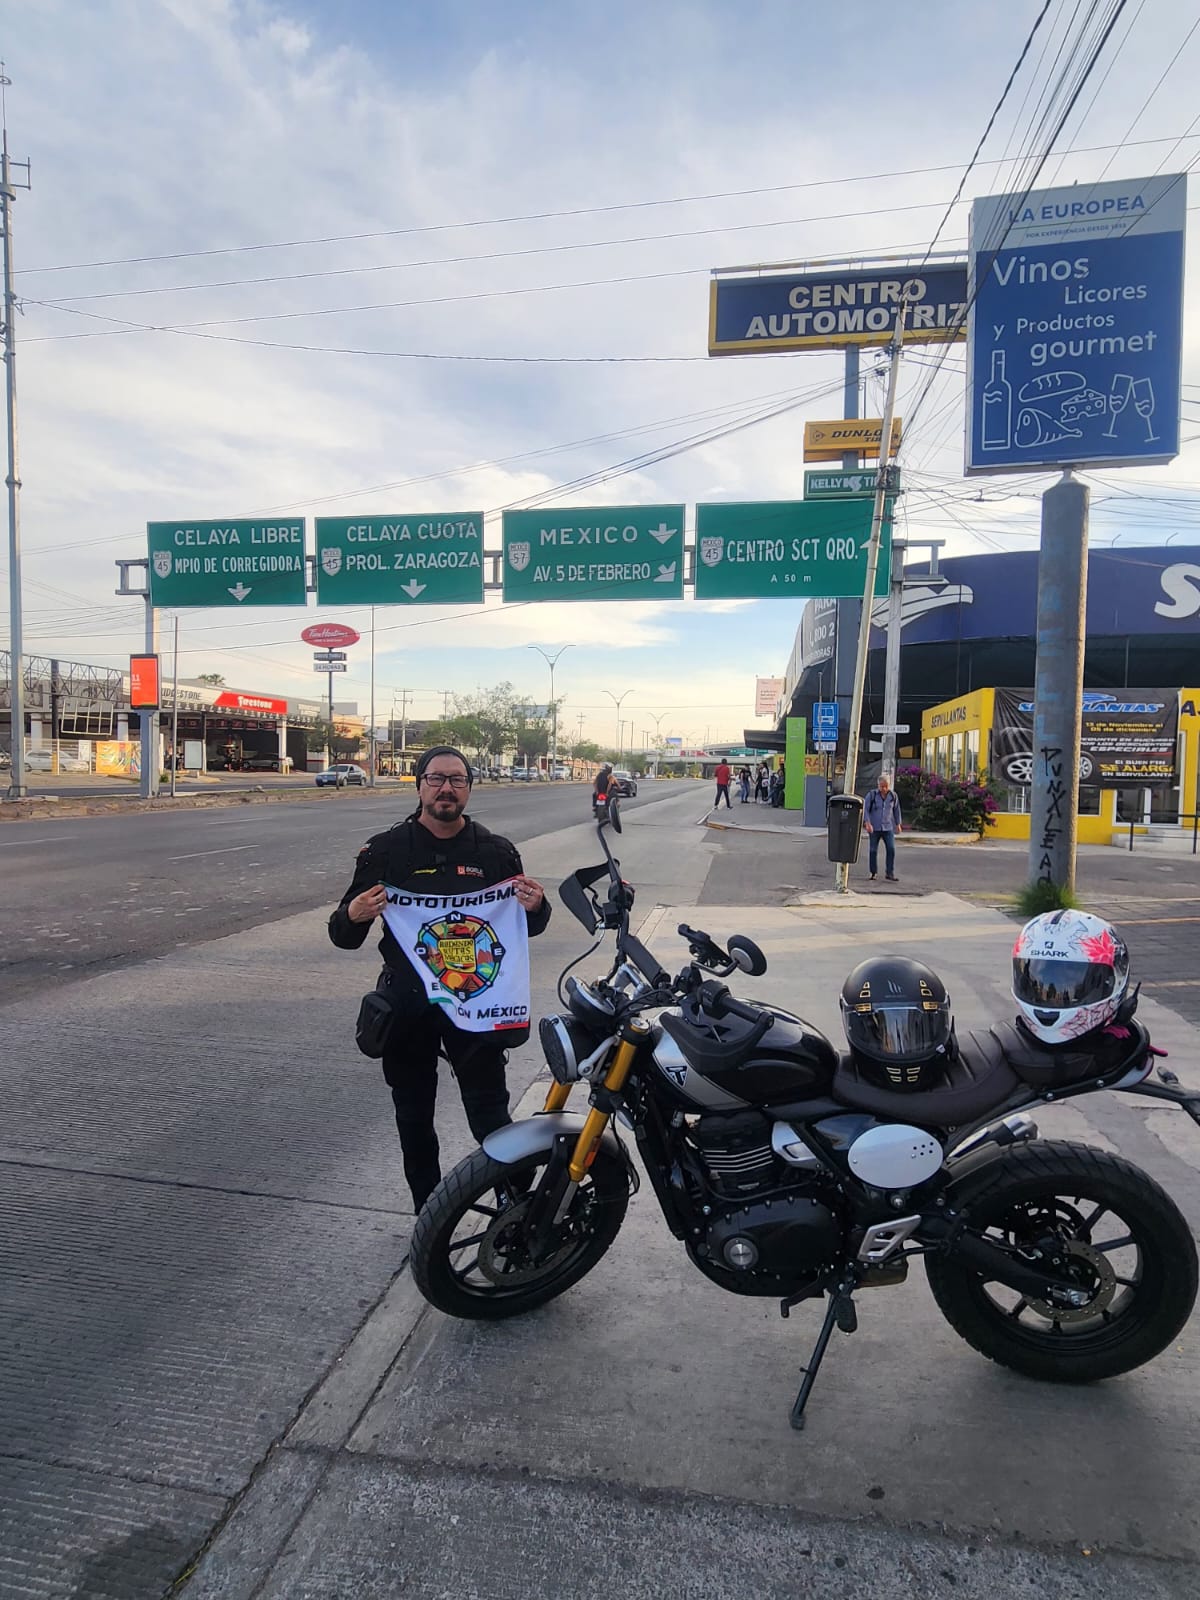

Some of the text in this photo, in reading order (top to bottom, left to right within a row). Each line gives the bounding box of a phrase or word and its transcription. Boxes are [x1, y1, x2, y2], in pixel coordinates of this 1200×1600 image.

[1009, 195, 1145, 224] LA EUROPEA
[992, 255, 1090, 287] Vinos
[788, 278, 927, 310] CENTRO
[1064, 284, 1148, 305] Licores
[745, 302, 967, 339] AUTOMOTRIZ
[993, 313, 1115, 342] y Productos
[1030, 330, 1158, 367] gourmet
[831, 428, 886, 439] DUNLO
[810, 478, 843, 489] KELLY
[174, 526, 301, 546] CELAYA LIBRE
[346, 521, 478, 542] CELAYA CUOTA
[539, 525, 638, 546] MEXICO
[513, 552, 526, 565] 57
[705, 549, 719, 561] 45
[727, 537, 859, 563] CENTRO SCT QRO.
[157, 558, 168, 572] 45
[175, 556, 302, 574] MPIO DE CORREGIDORA
[326, 558, 338, 570] 45
[346, 551, 480, 571] PROL. ZARAGOZA
[533, 562, 650, 583] AV. 5 DE FEBRERO
[770, 574, 812, 583] A 50 m
[1030, 949, 1069, 958] SHARK
[476, 1003, 528, 1020] MÉXICO
